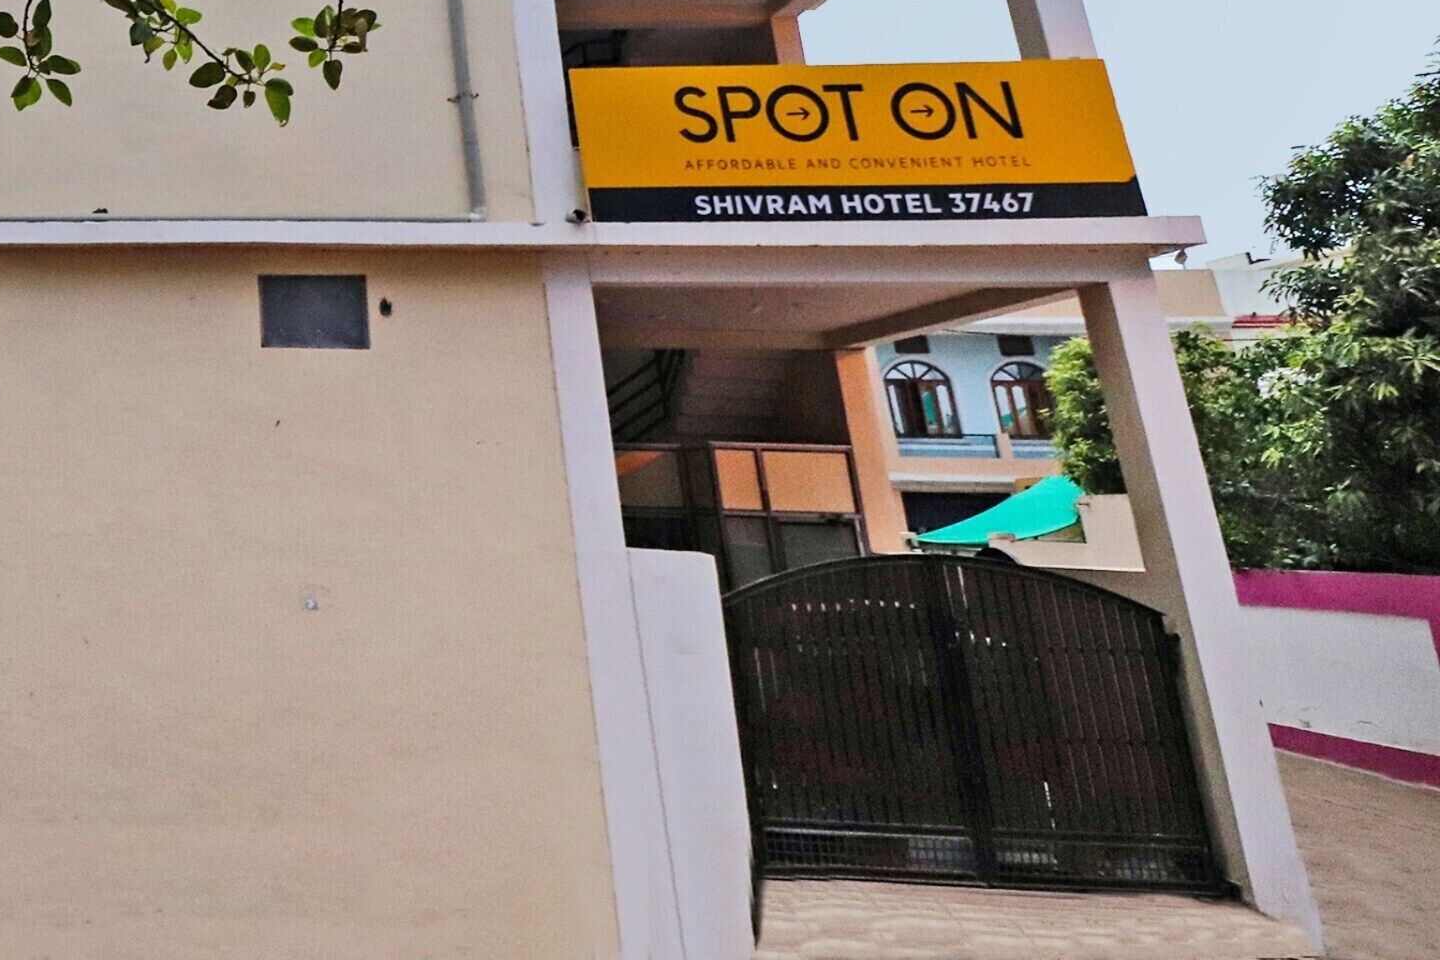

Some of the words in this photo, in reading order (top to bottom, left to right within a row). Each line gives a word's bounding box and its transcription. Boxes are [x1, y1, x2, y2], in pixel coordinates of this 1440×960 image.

[674, 84, 864, 143] SPOT
[890, 81, 1025, 140] ON
[684, 157, 797, 171] AFFORDABLE
[806, 157, 842, 170] AND
[846, 156, 964, 170] CONVENIENT
[972, 155, 1033, 168] HOTEL
[694, 193, 832, 216] SHIVRAM
[840, 193, 942, 215] HOTEL
[948, 192, 1035, 214] 37467
